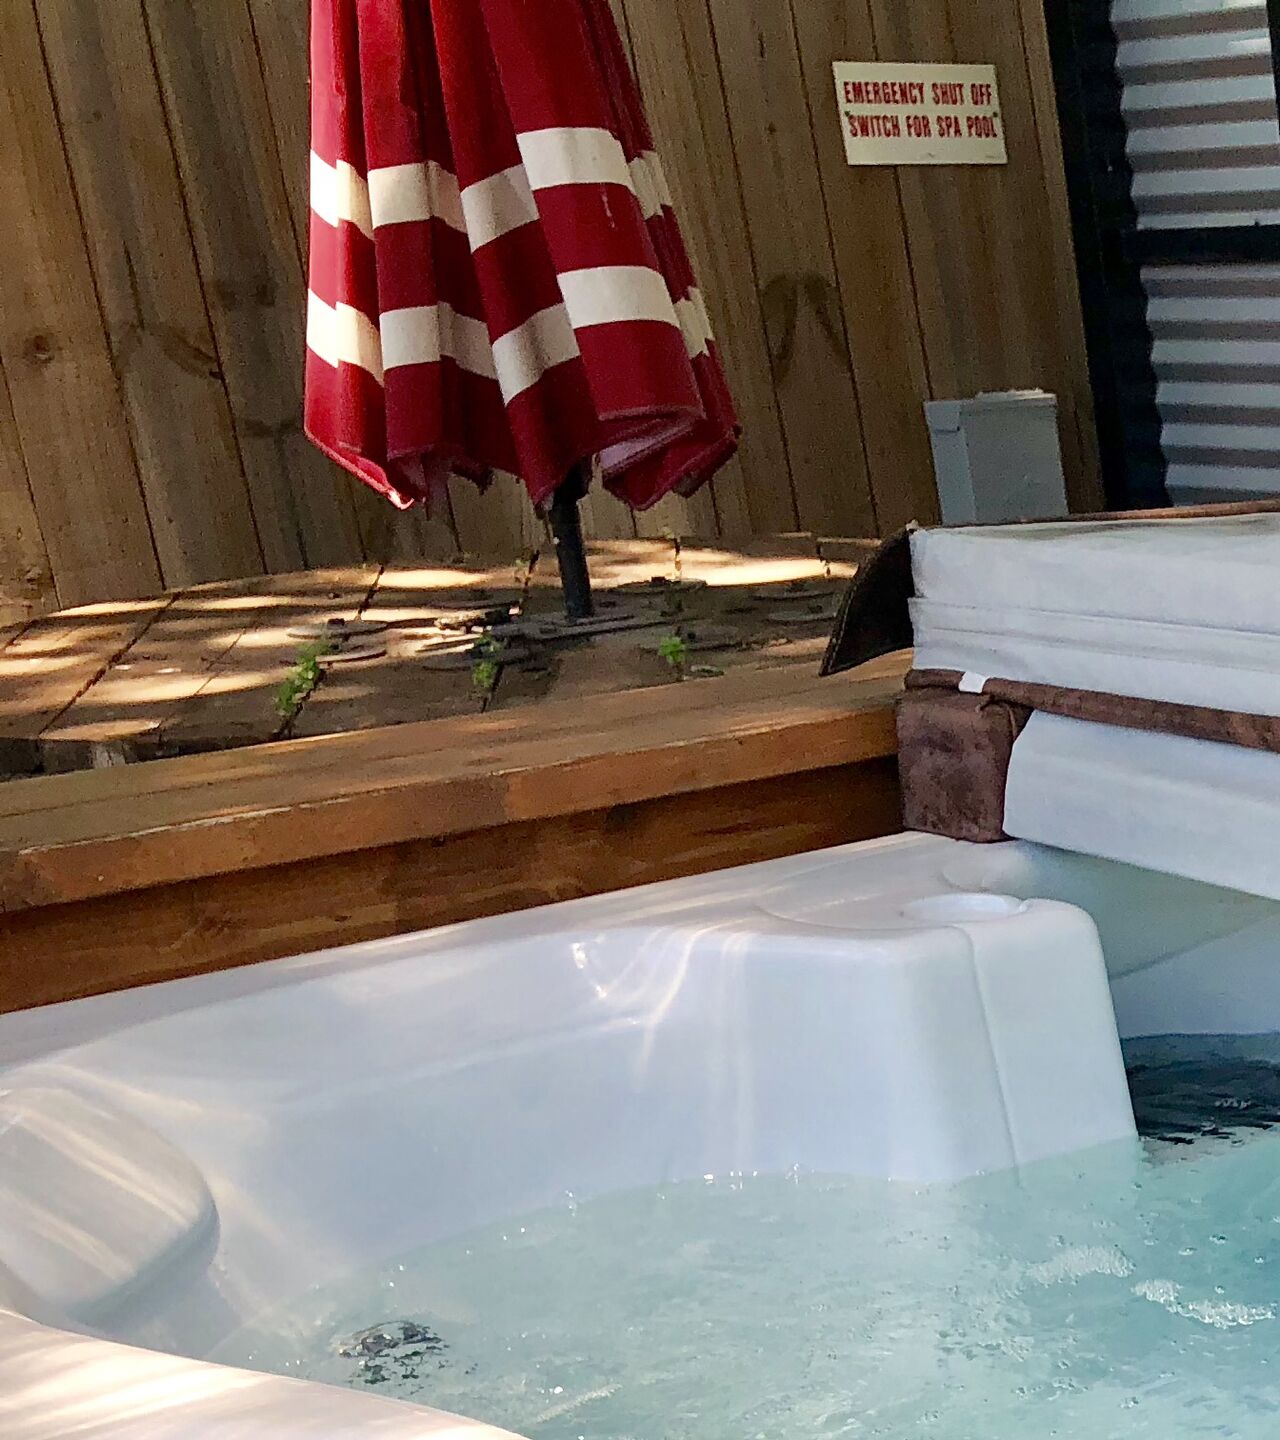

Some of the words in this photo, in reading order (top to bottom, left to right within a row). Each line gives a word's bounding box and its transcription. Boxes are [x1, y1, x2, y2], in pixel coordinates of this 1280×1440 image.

[843, 81, 925, 105] EMERGENCY
[931, 82, 965, 106] SHUT
[970, 83, 992, 106] OFF
[849, 115, 901, 138] SWITCH
[905, 115, 932, 138] FOR
[936, 115, 962, 138] SPA
[966, 115, 998, 139] POOL
